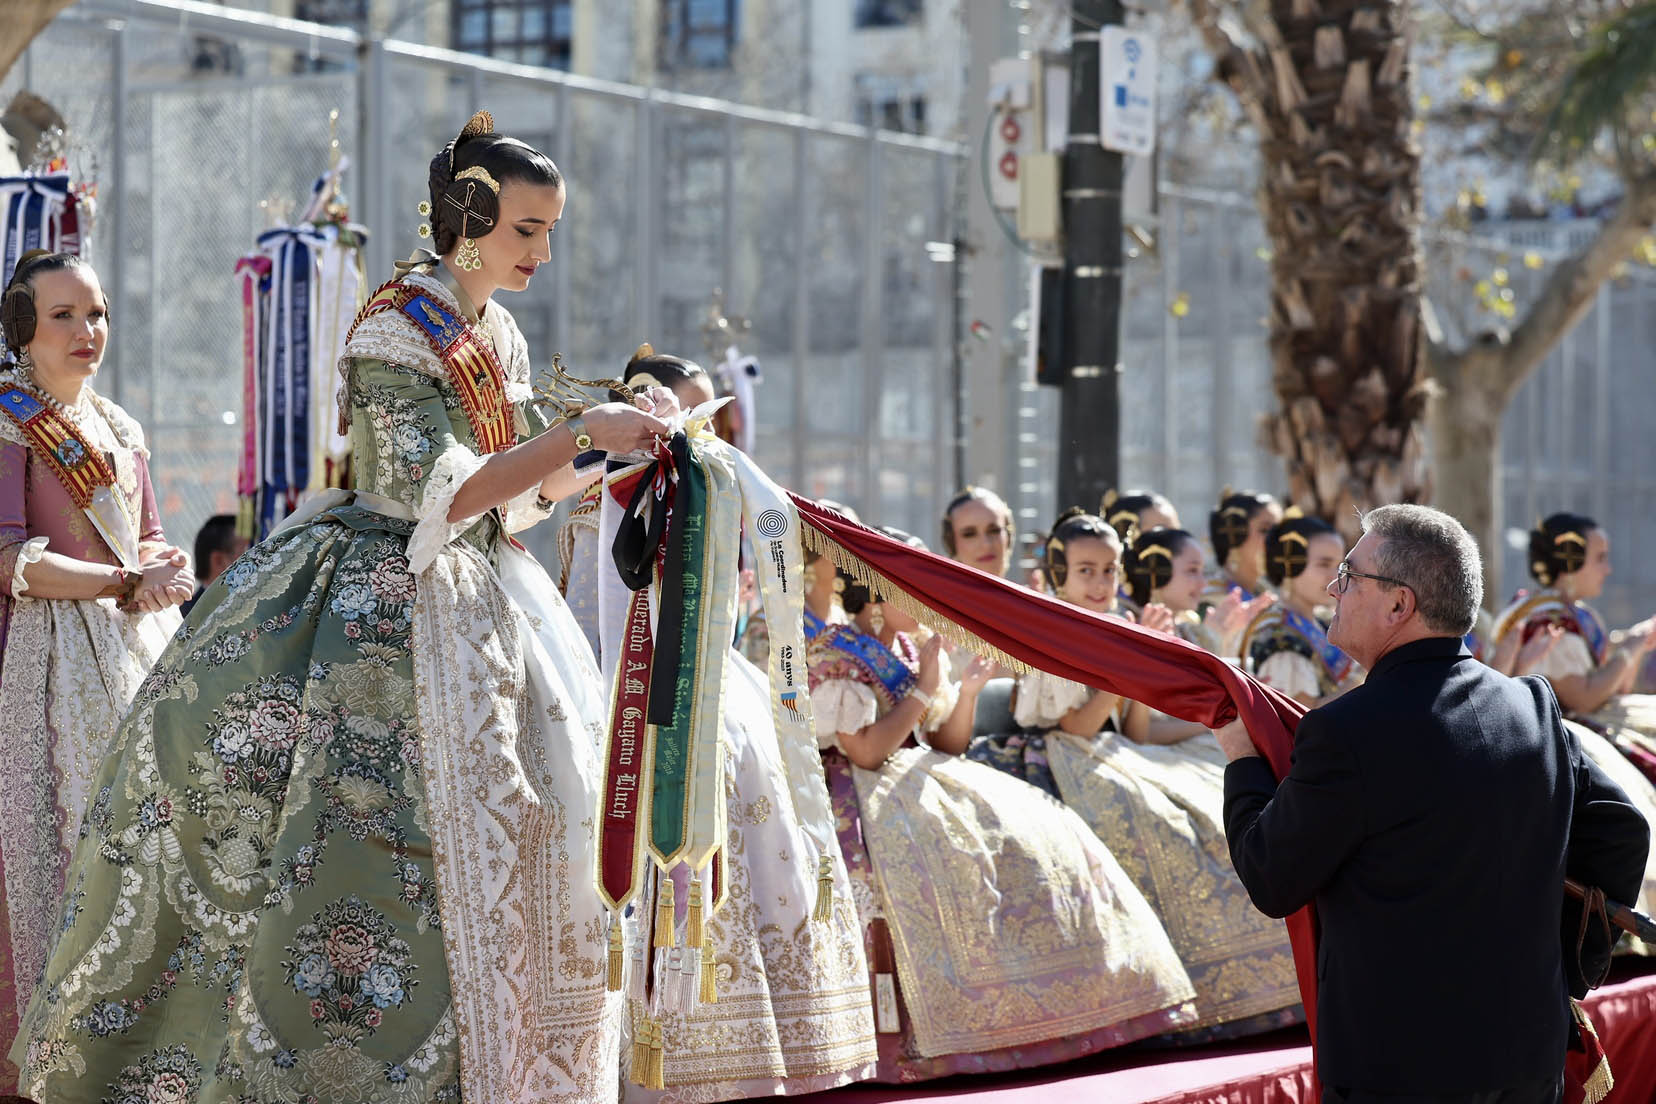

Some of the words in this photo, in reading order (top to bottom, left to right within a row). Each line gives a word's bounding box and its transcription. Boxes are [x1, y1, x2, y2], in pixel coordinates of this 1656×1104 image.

[778, 550, 788, 593] Coordinadora
[785, 645, 793, 659] 40
[784, 661, 793, 687] anys
[617, 706, 643, 766] Gayano
[608, 772, 637, 819] Lluch
